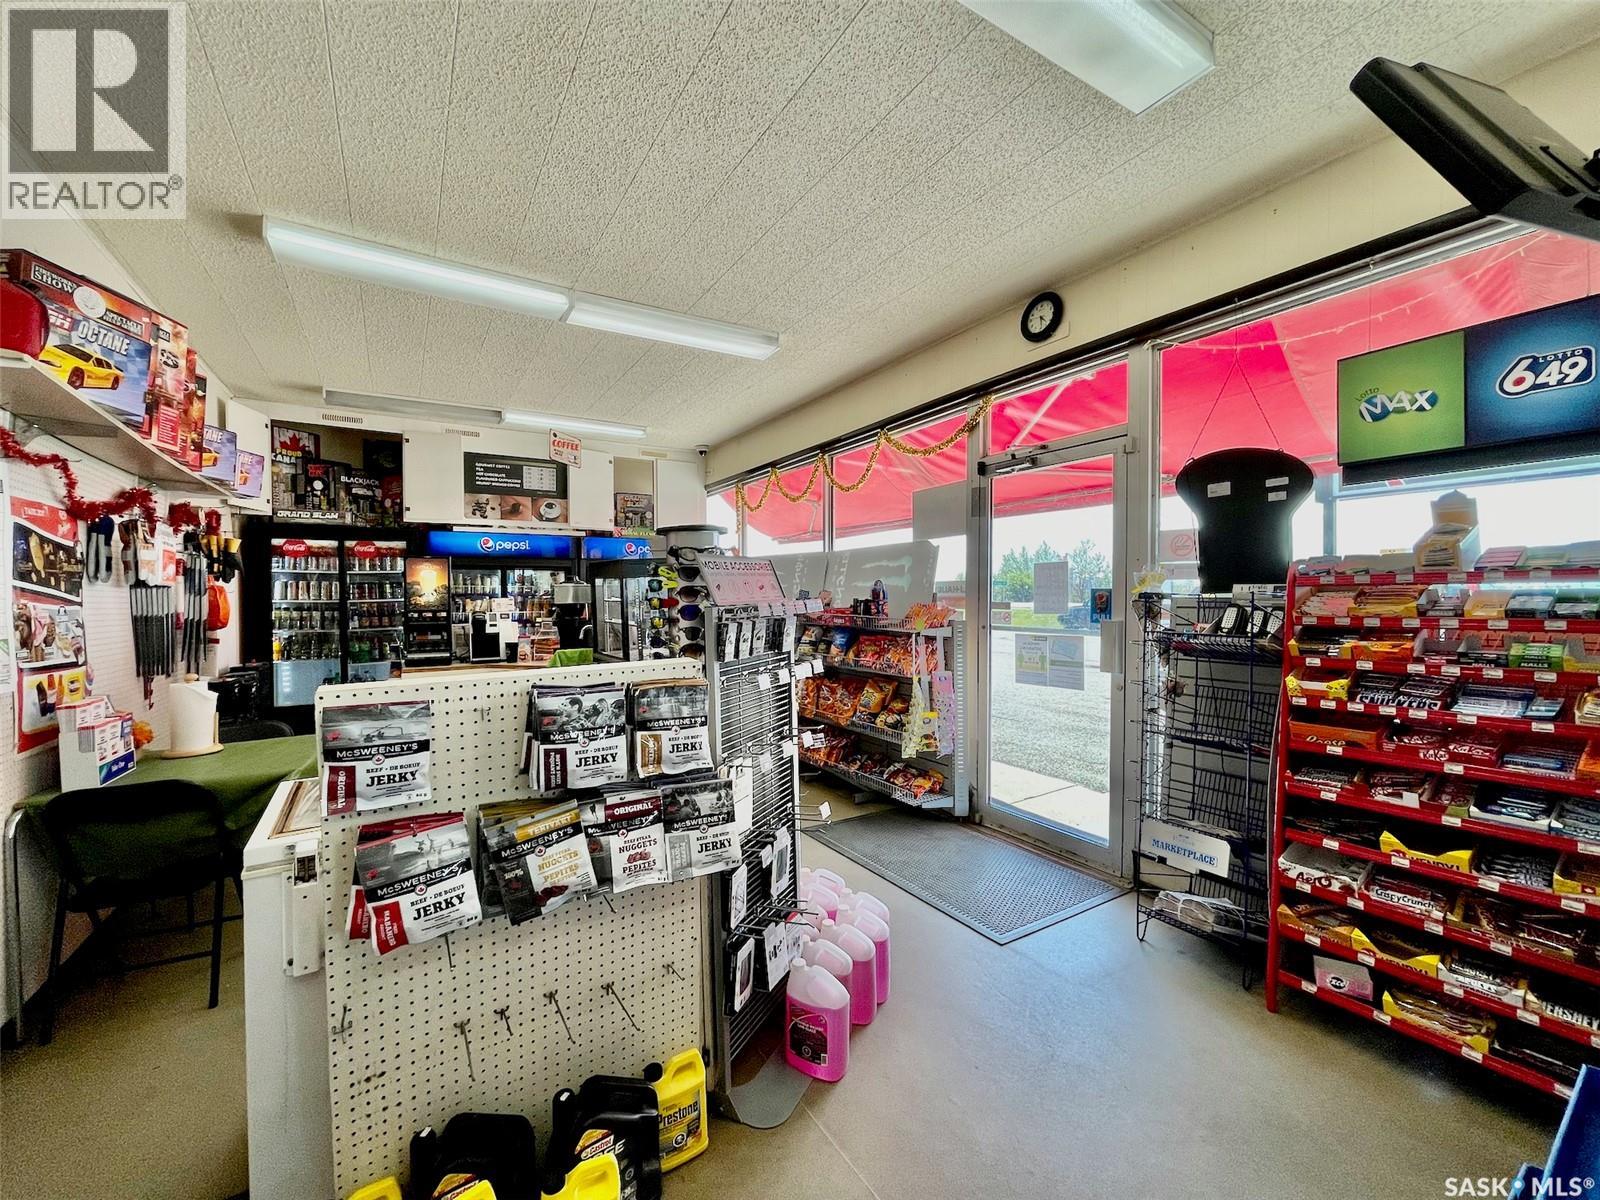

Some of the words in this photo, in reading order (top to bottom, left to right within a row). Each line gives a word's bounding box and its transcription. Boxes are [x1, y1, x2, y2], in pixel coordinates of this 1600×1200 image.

[34, 271, 75, 294] SHOW
[77, 320, 131, 356] OCTANE
[1538, 348, 1584, 363] LOTTO
[1502, 355, 1588, 394] 649
[1354, 386, 1380, 402] Lotto
[1359, 390, 1433, 423] MAX
[276, 448, 302, 458] PROUD
[552, 439, 579, 451] COFFEE
[340, 475, 380, 487] BLACKJACK
[277, 510, 311, 519] GRAND
[312, 511, 339, 520] SLAM
[495, 540, 531, 551] pepsi
[703, 560, 729, 571] MOBILE
[336, 742, 419, 759] McSWEENEY'S
[668, 741, 703, 754] JERKY
[575, 752, 619, 768] JERKY
[365, 766, 383, 774] BEEF
[365, 769, 419, 788] JERKY
[336, 770, 346, 809] ORIGINAL
[613, 801, 653, 815] ORIGINAL
[501, 826, 574, 858] McSWEENEY'S
[618, 838, 658, 854] NUGGETS
[697, 837, 732, 854] JERKY
[1151, 839, 1216, 866] MARKETPLACE
[503, 868, 524, 880] 100%
[622, 858, 657, 874] PEPITES
[377, 865, 460, 898] McSWEENEY'S
[410, 897, 428, 907] BEEF
[412, 891, 466, 921] JERKY
[658, 1099, 699, 1127] Prestone
[587, 1137, 614, 1156] Castrol
